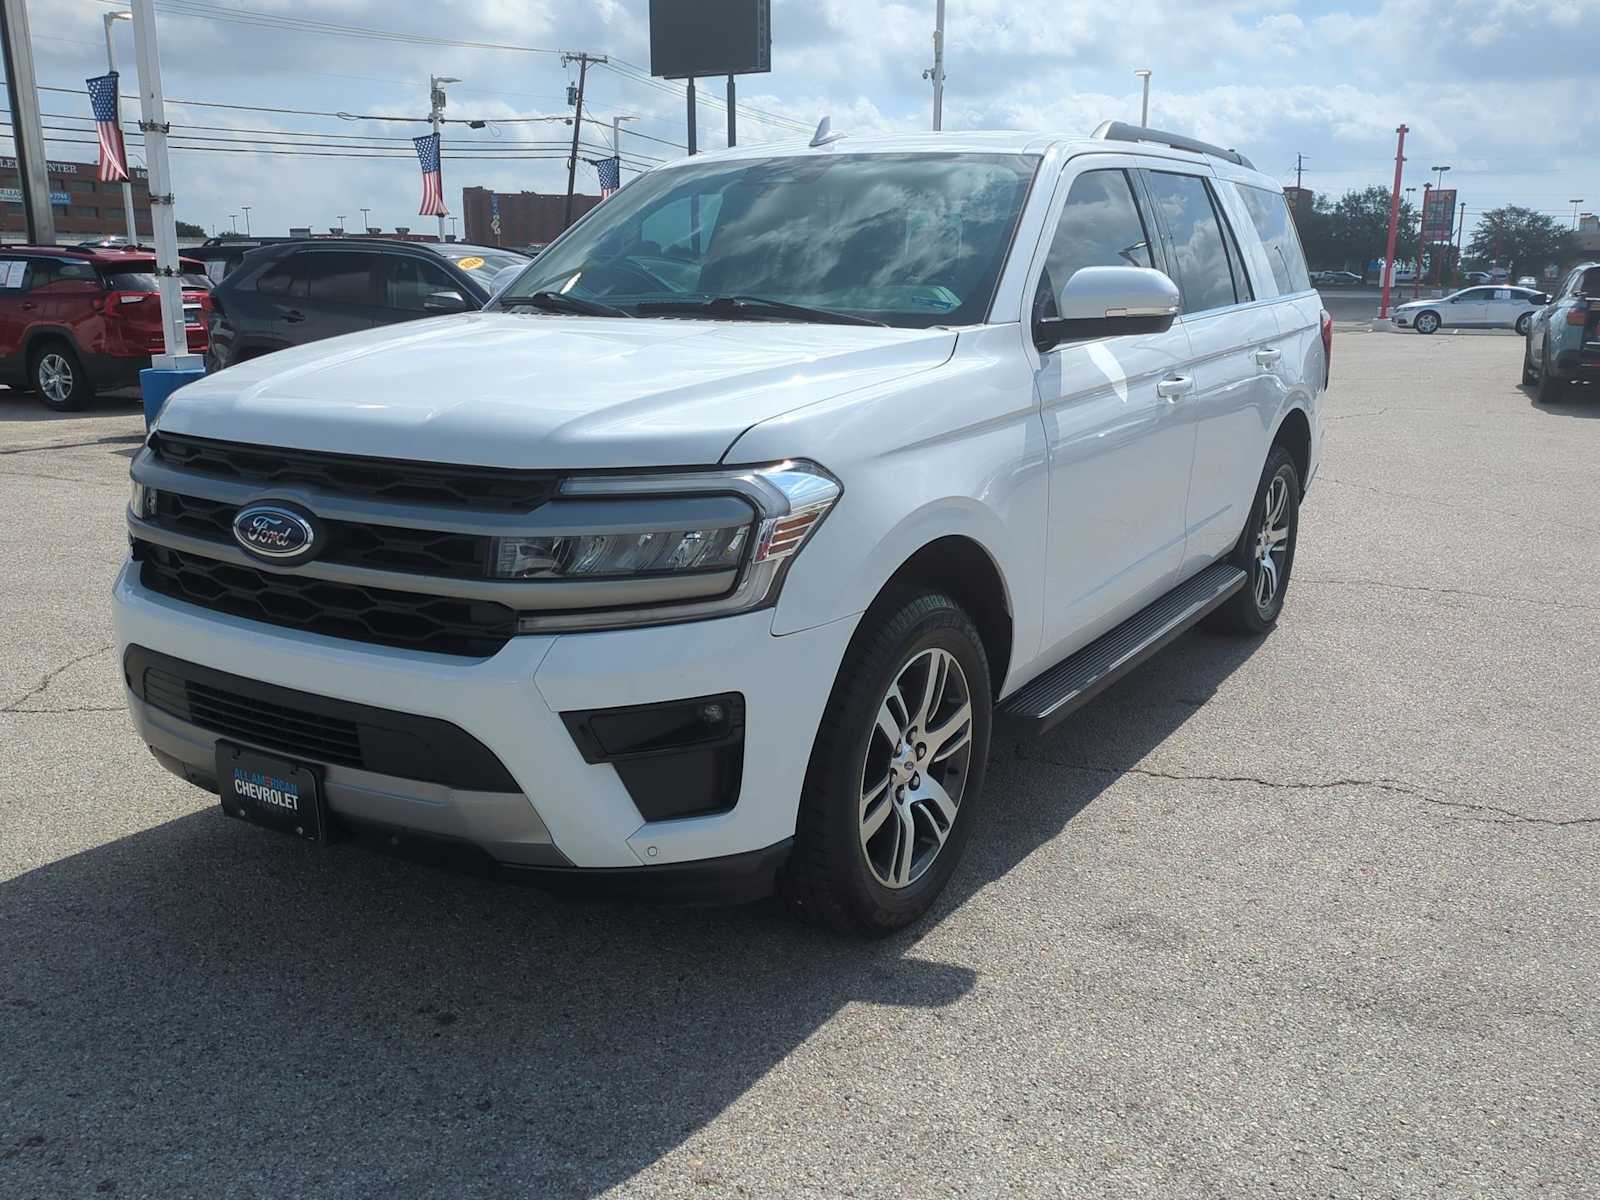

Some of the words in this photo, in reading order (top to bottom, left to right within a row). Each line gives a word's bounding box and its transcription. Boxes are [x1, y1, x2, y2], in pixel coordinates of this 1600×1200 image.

[48, 162, 77, 173] NTER
[248, 516, 291, 546] Ford
[234, 779, 298, 810] CHEVROLET
